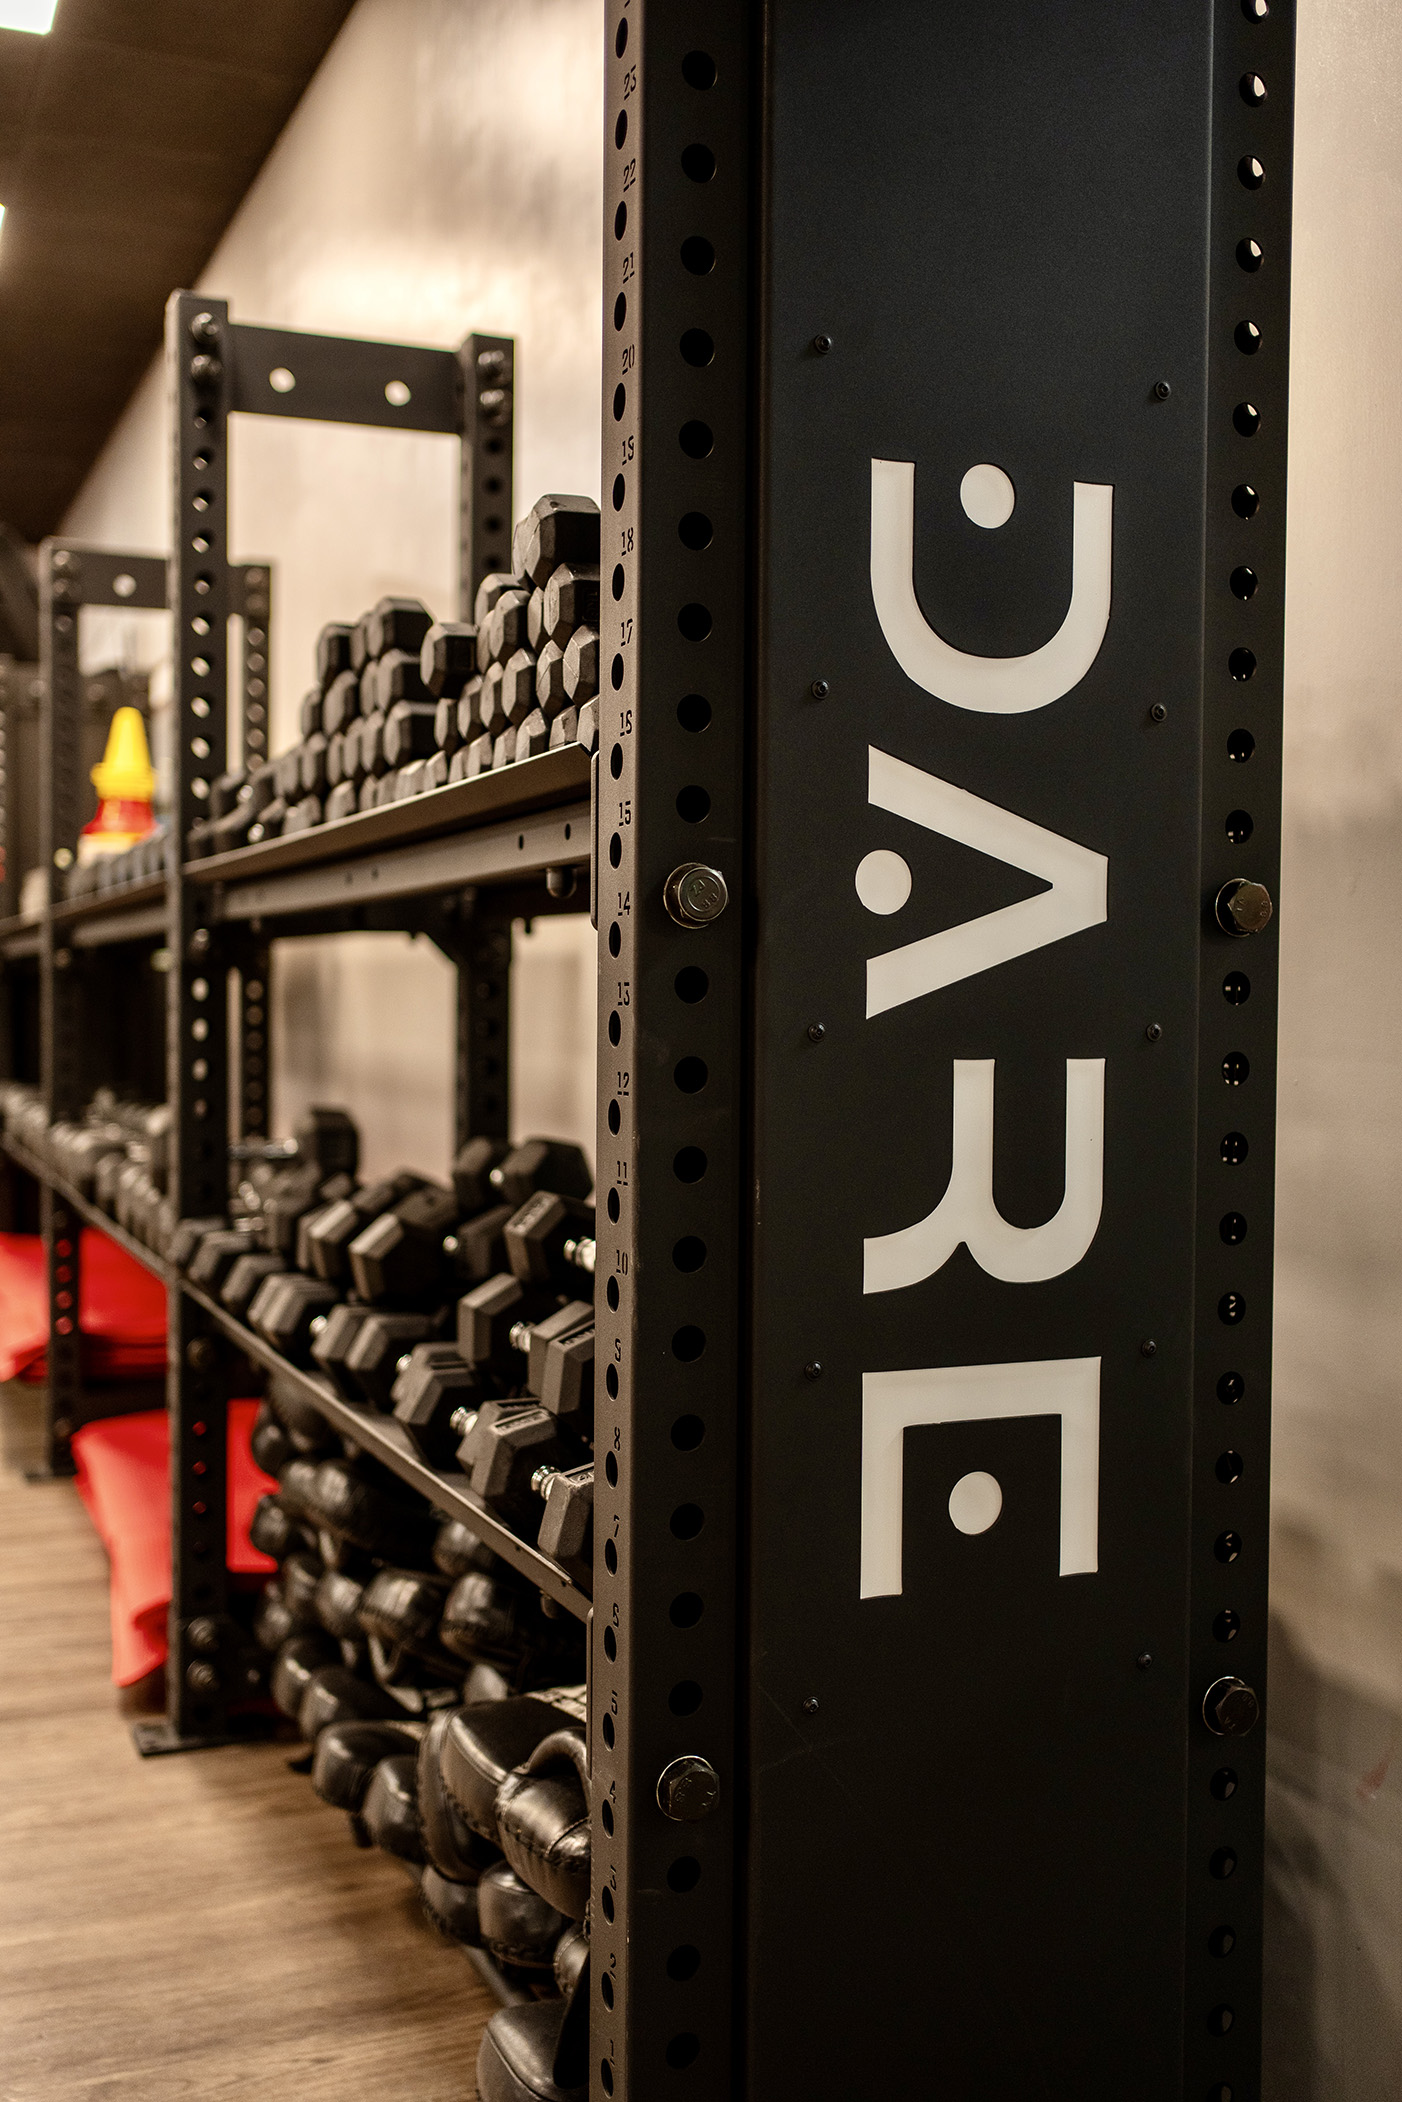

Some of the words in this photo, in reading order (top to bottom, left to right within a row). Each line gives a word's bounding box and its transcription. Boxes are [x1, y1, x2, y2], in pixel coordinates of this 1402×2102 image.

[623, 64, 637, 101] 23
[623, 158, 636, 193] 22
[622, 251, 635, 285] 21
[621, 344, 635, 376] 20
[621, 526, 634, 557] 18
[620, 618, 634, 647] 17
[618, 800, 632, 827] 15
[617, 891, 631, 917] 14
[617, 981, 630, 1006] 13
[854, 457, 1114, 1600] DARE
[617, 1071, 630, 1097] 12
[616, 1160, 629, 1186] 11
[615, 1249, 629, 1276] 10
[613, 1426, 621, 1451] 8
